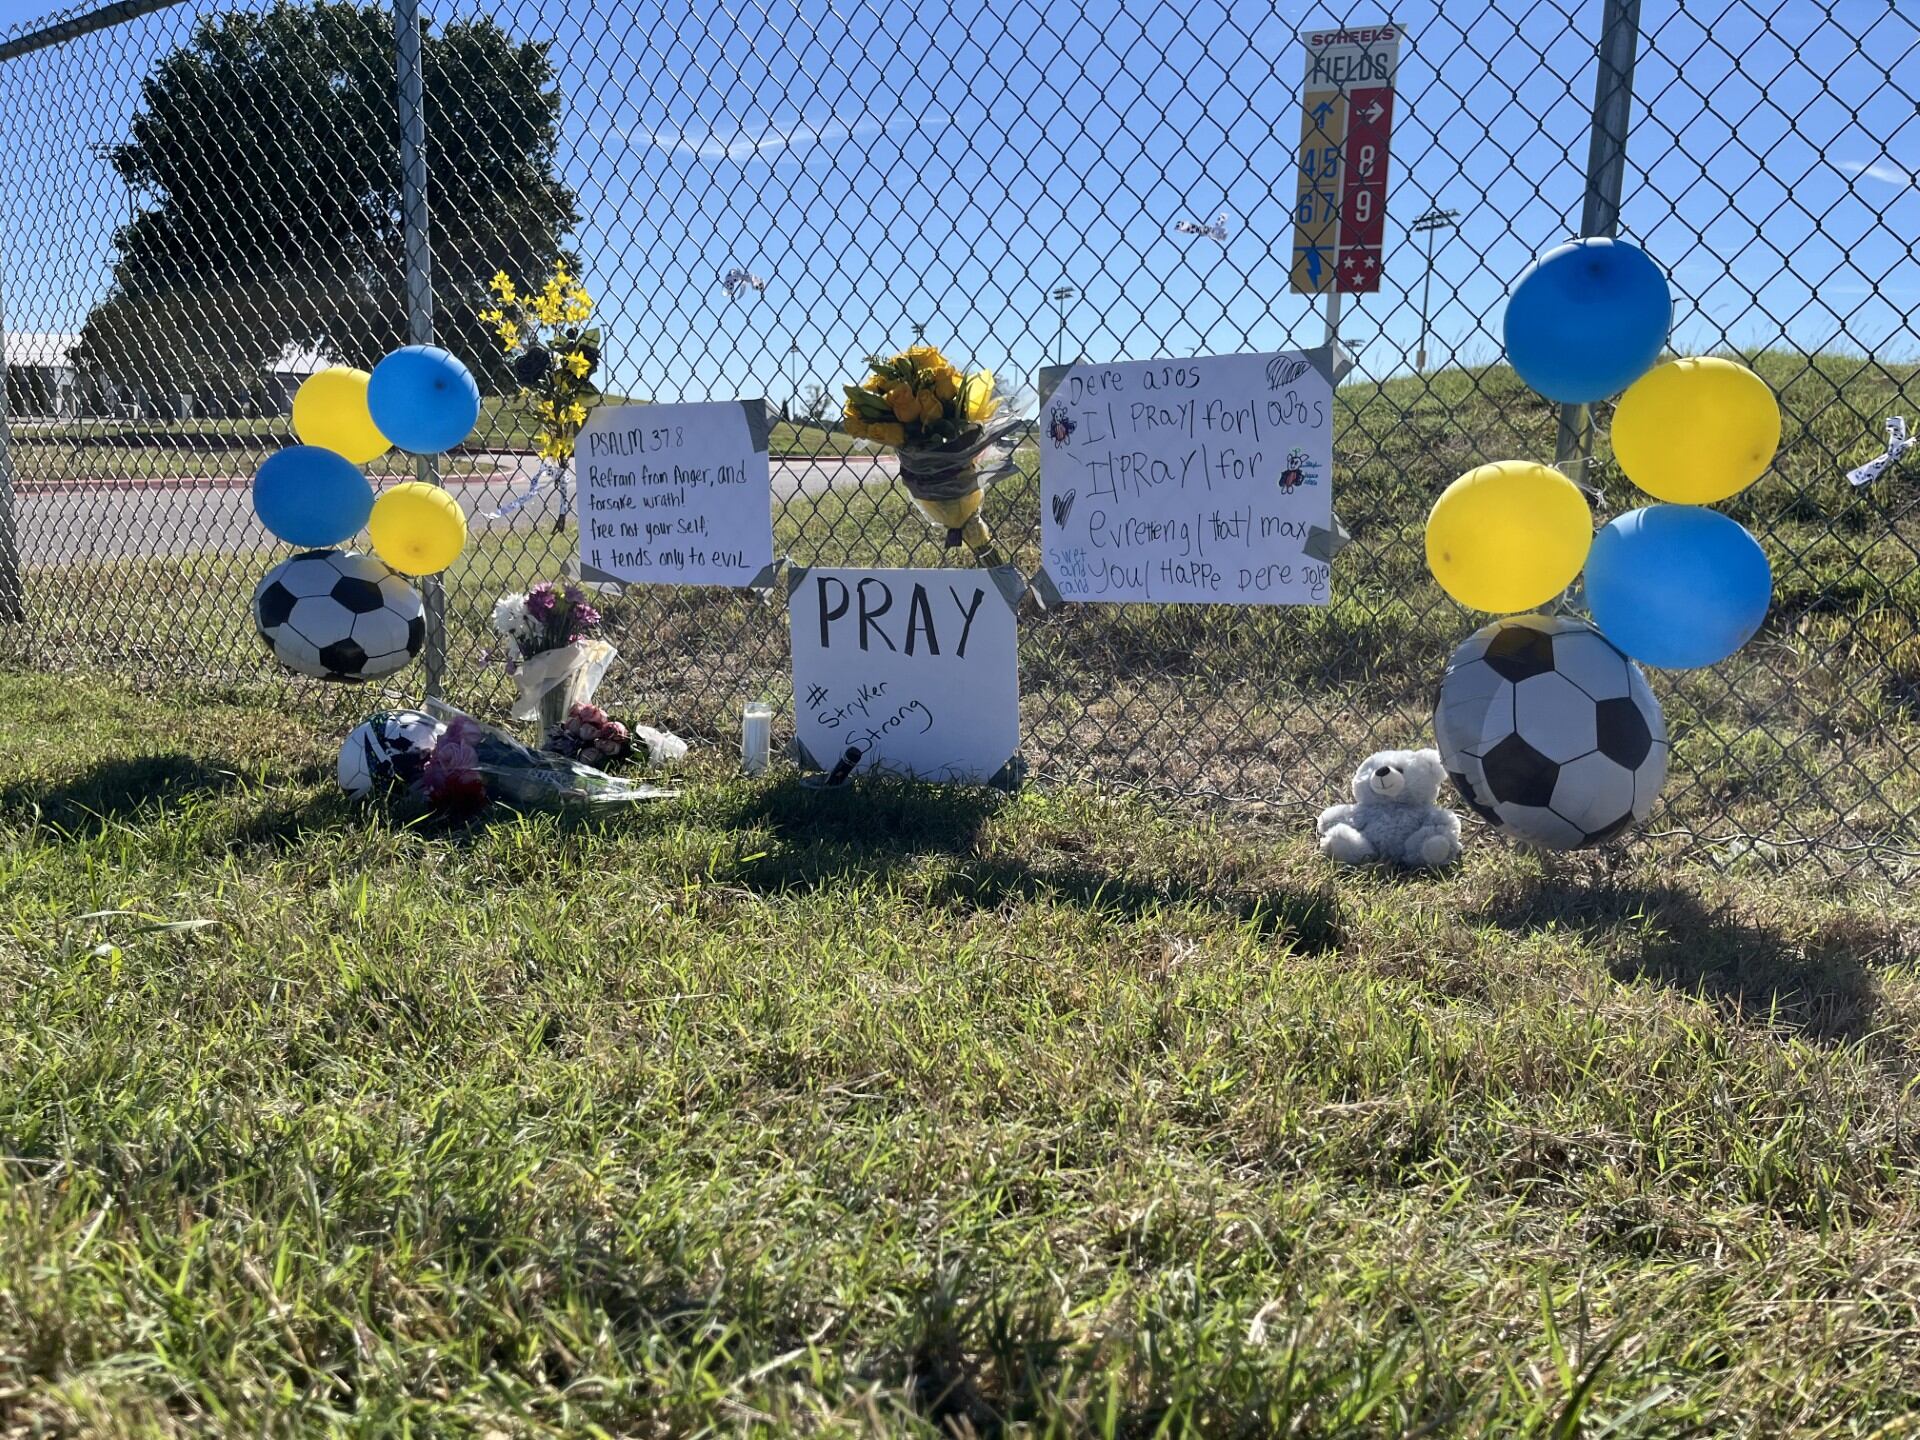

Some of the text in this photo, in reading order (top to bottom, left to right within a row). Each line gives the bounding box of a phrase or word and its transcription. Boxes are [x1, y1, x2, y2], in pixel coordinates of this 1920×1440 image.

[1311, 28, 1394, 46] SCHEELS
[1312, 53, 1389, 84] FIELDS
[1301, 147, 1338, 178] 4 5
[1358, 145, 1376, 177] 8
[1299, 192, 1335, 224] 6 7
[1355, 190, 1372, 222] 9
[590, 428, 645, 457] PSALM
[589, 459, 747, 488] Refrain from Anger, and
[642, 487, 685, 509] wrath!
[620, 522, 639, 537] not
[645, 522, 673, 544] your
[611, 547, 652, 569] tends
[659, 548, 685, 571] only
[689, 546, 705, 567] to
[816, 576, 985, 660] PRAY
[818, 681, 888, 729] Stryker
[845, 700, 933, 753] Strong
